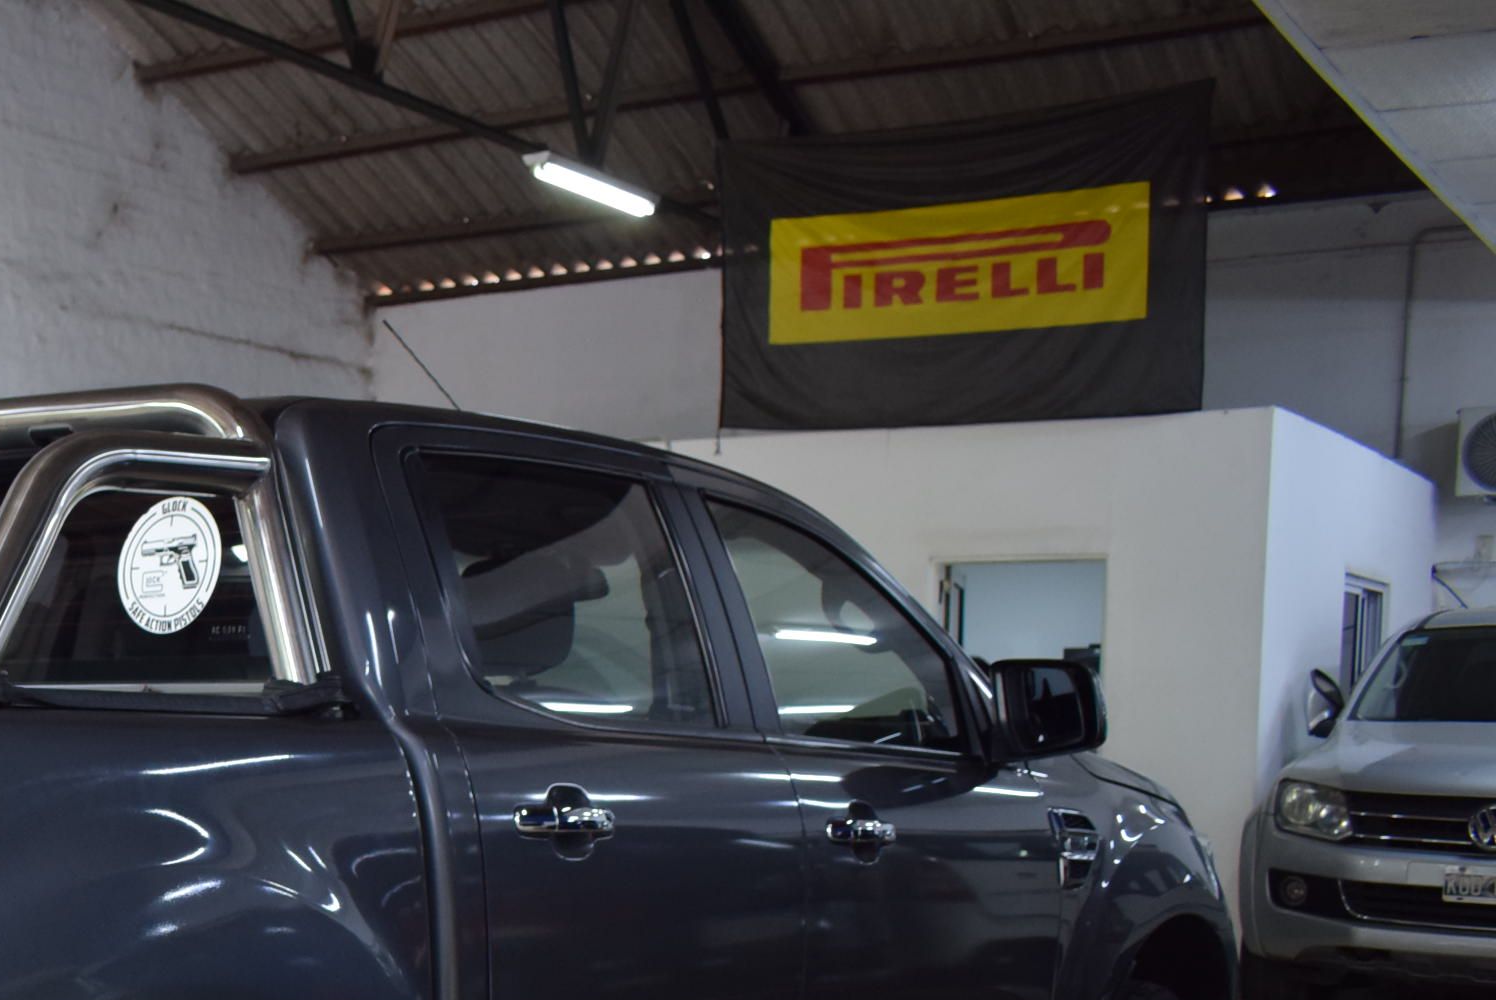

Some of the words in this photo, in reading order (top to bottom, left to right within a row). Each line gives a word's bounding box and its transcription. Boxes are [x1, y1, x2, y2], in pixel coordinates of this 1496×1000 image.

[801, 219, 1112, 313] PIRELLI
[161, 500, 188, 514] GLOCK
[129, 601, 146, 624] SAFE
[145, 616, 172, 632] ACTION
[173, 598, 205, 630] PISTOLS
